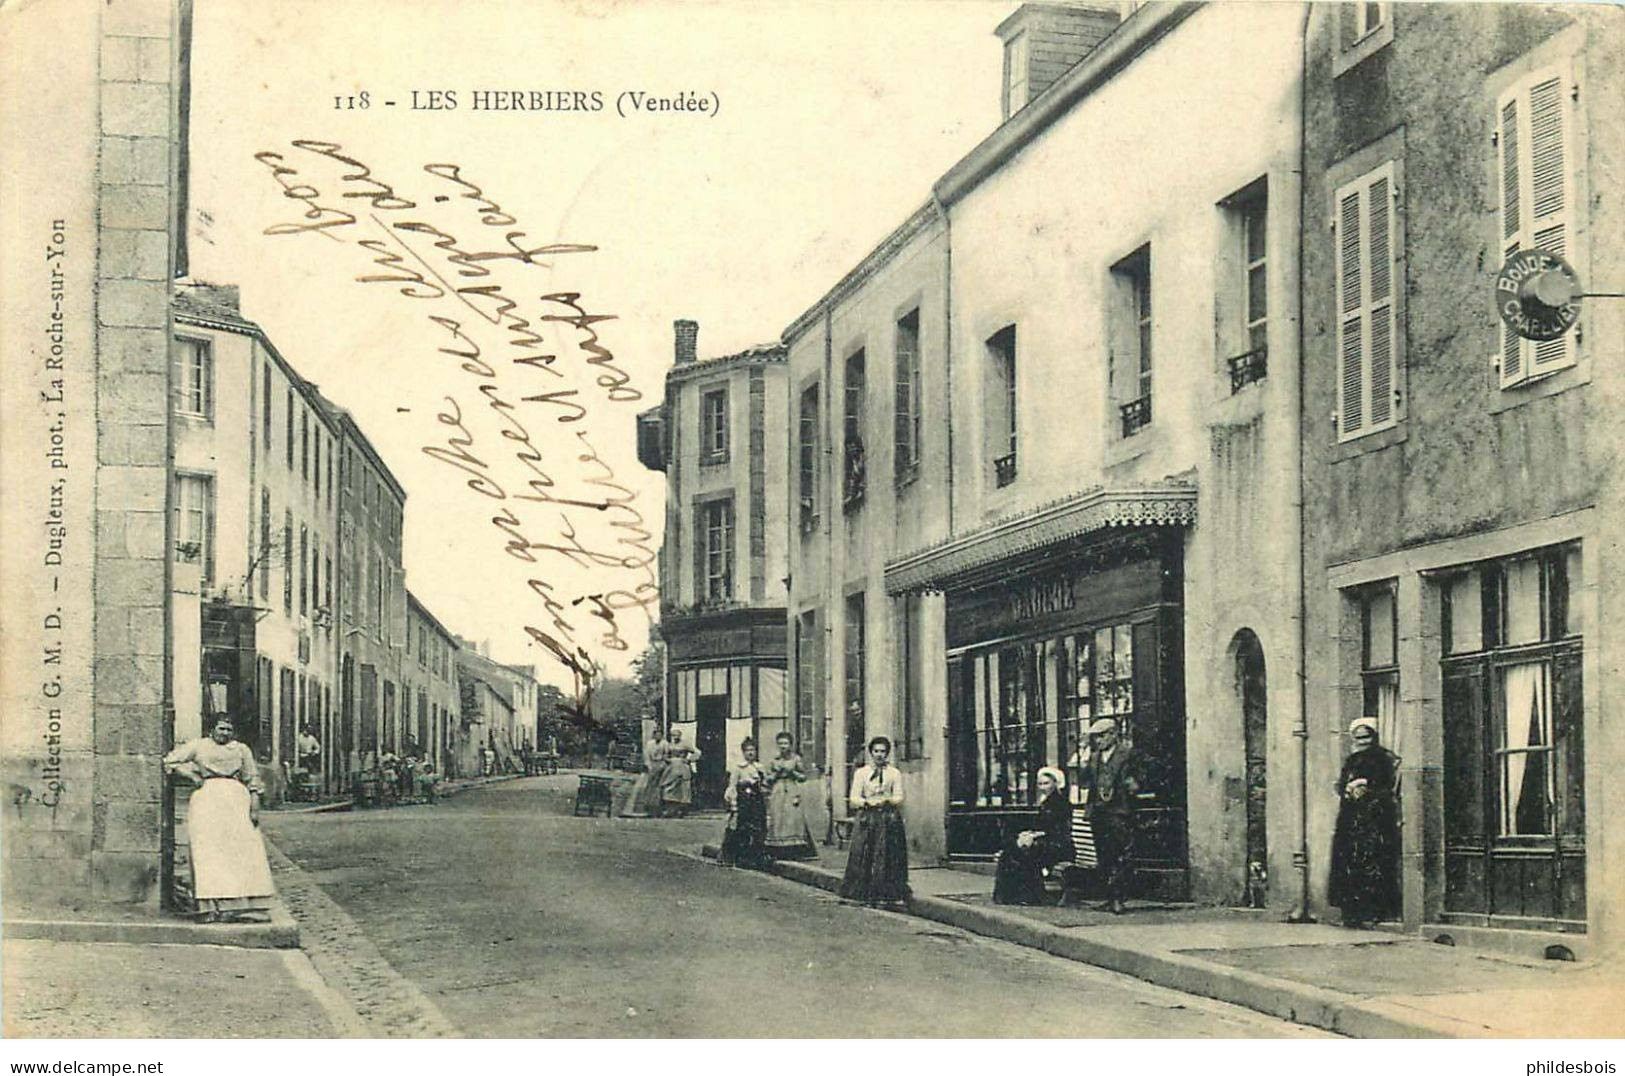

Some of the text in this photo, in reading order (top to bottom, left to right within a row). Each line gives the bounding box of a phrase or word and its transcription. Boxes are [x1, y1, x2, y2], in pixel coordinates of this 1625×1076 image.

[254, 151, 356, 242] bon
[424, 164, 598, 268] frais
[355, 240, 444, 298] du
